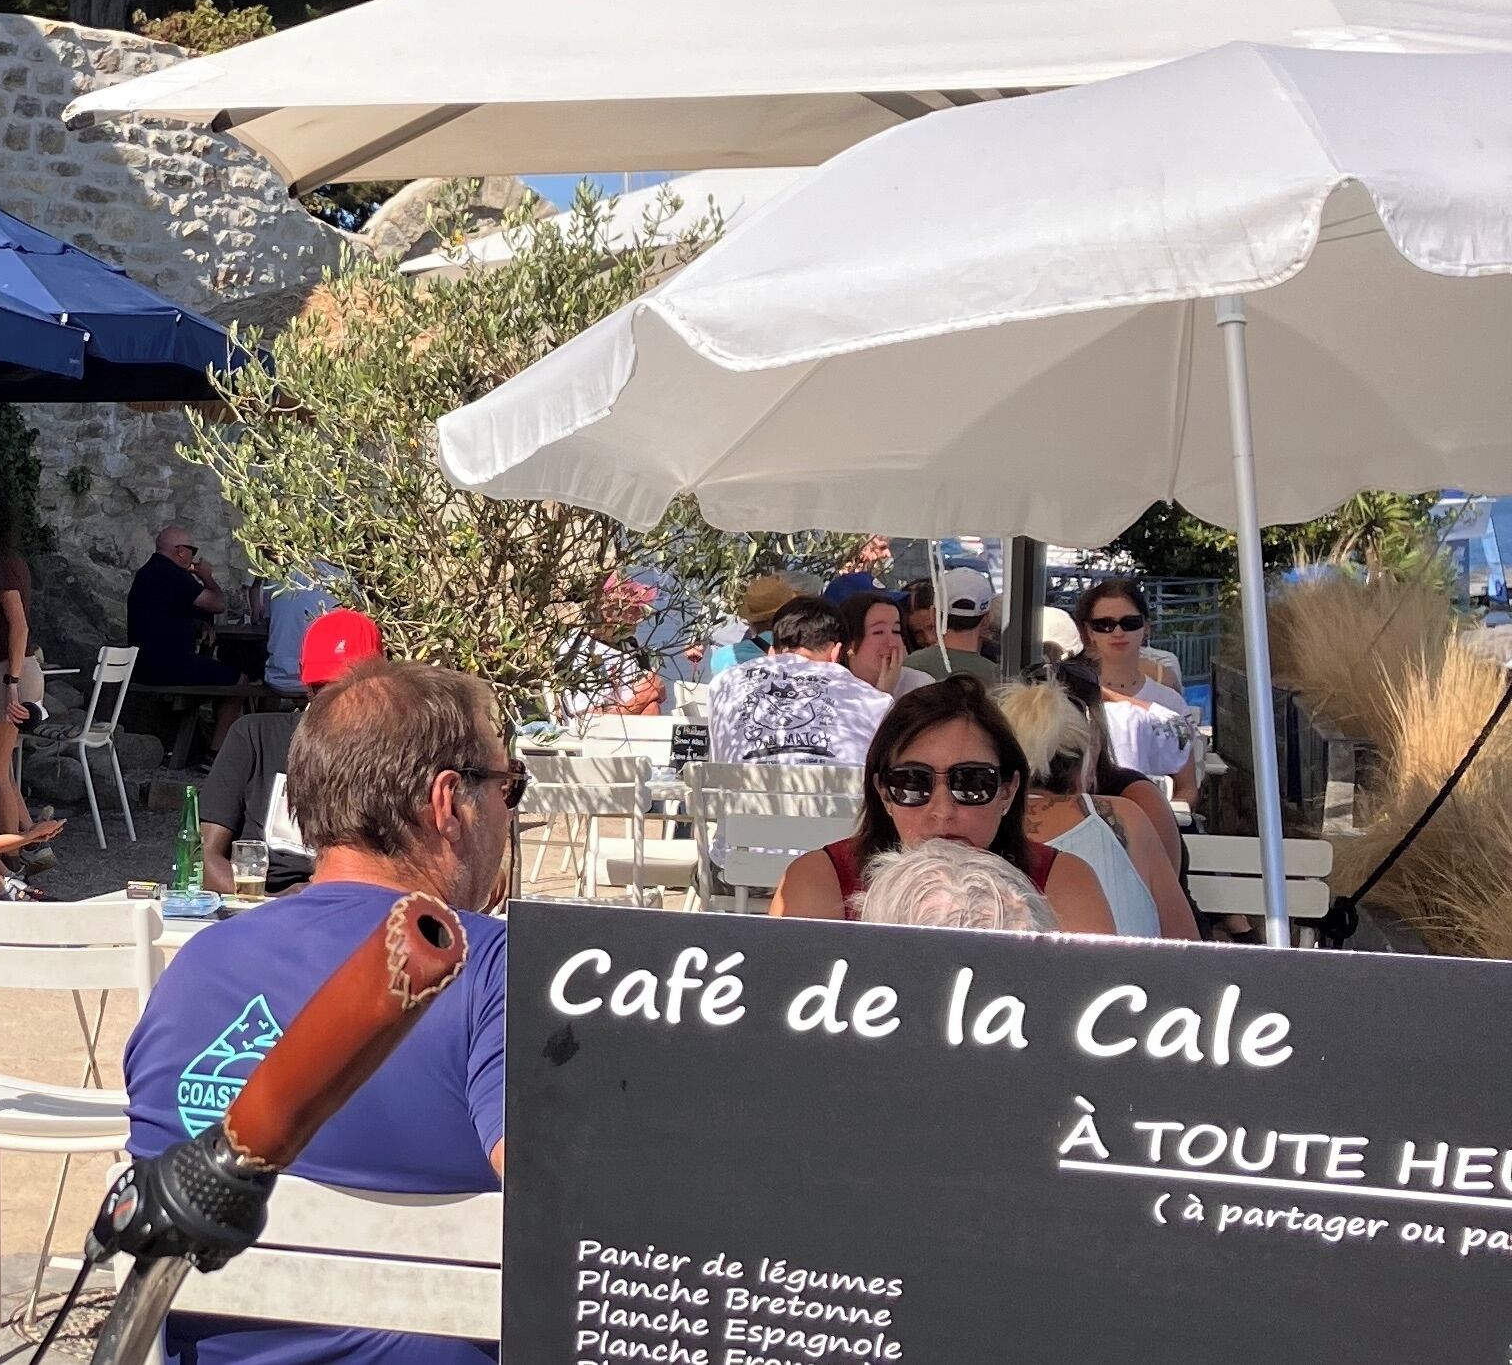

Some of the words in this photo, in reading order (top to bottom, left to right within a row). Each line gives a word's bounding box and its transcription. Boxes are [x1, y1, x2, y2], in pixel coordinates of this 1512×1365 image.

[549, 947, 746, 1027] Café
[787, 959, 901, 1038] de
[947, 968, 1029, 1050] la
[1075, 984, 1293, 1068] Cale
[1059, 1095, 1110, 1159] À
[1134, 1121, 1370, 1180] TOUTE
[1218, 1204, 1389, 1242] partager
[1401, 1222, 1446, 1244] ou
[1460, 1226, 1512, 1256] pa
[578, 1240, 691, 1272] Panier
[702, 1253, 744, 1279] de
[760, 1258, 904, 1298] légumes
[577, 1270, 710, 1306] Planche
[725, 1288, 893, 1327] Bretonne
[576, 1300, 710, 1336] Planche
[724, 1319, 903, 1360] Espagnole
[576, 1330, 709, 1365] Planche
